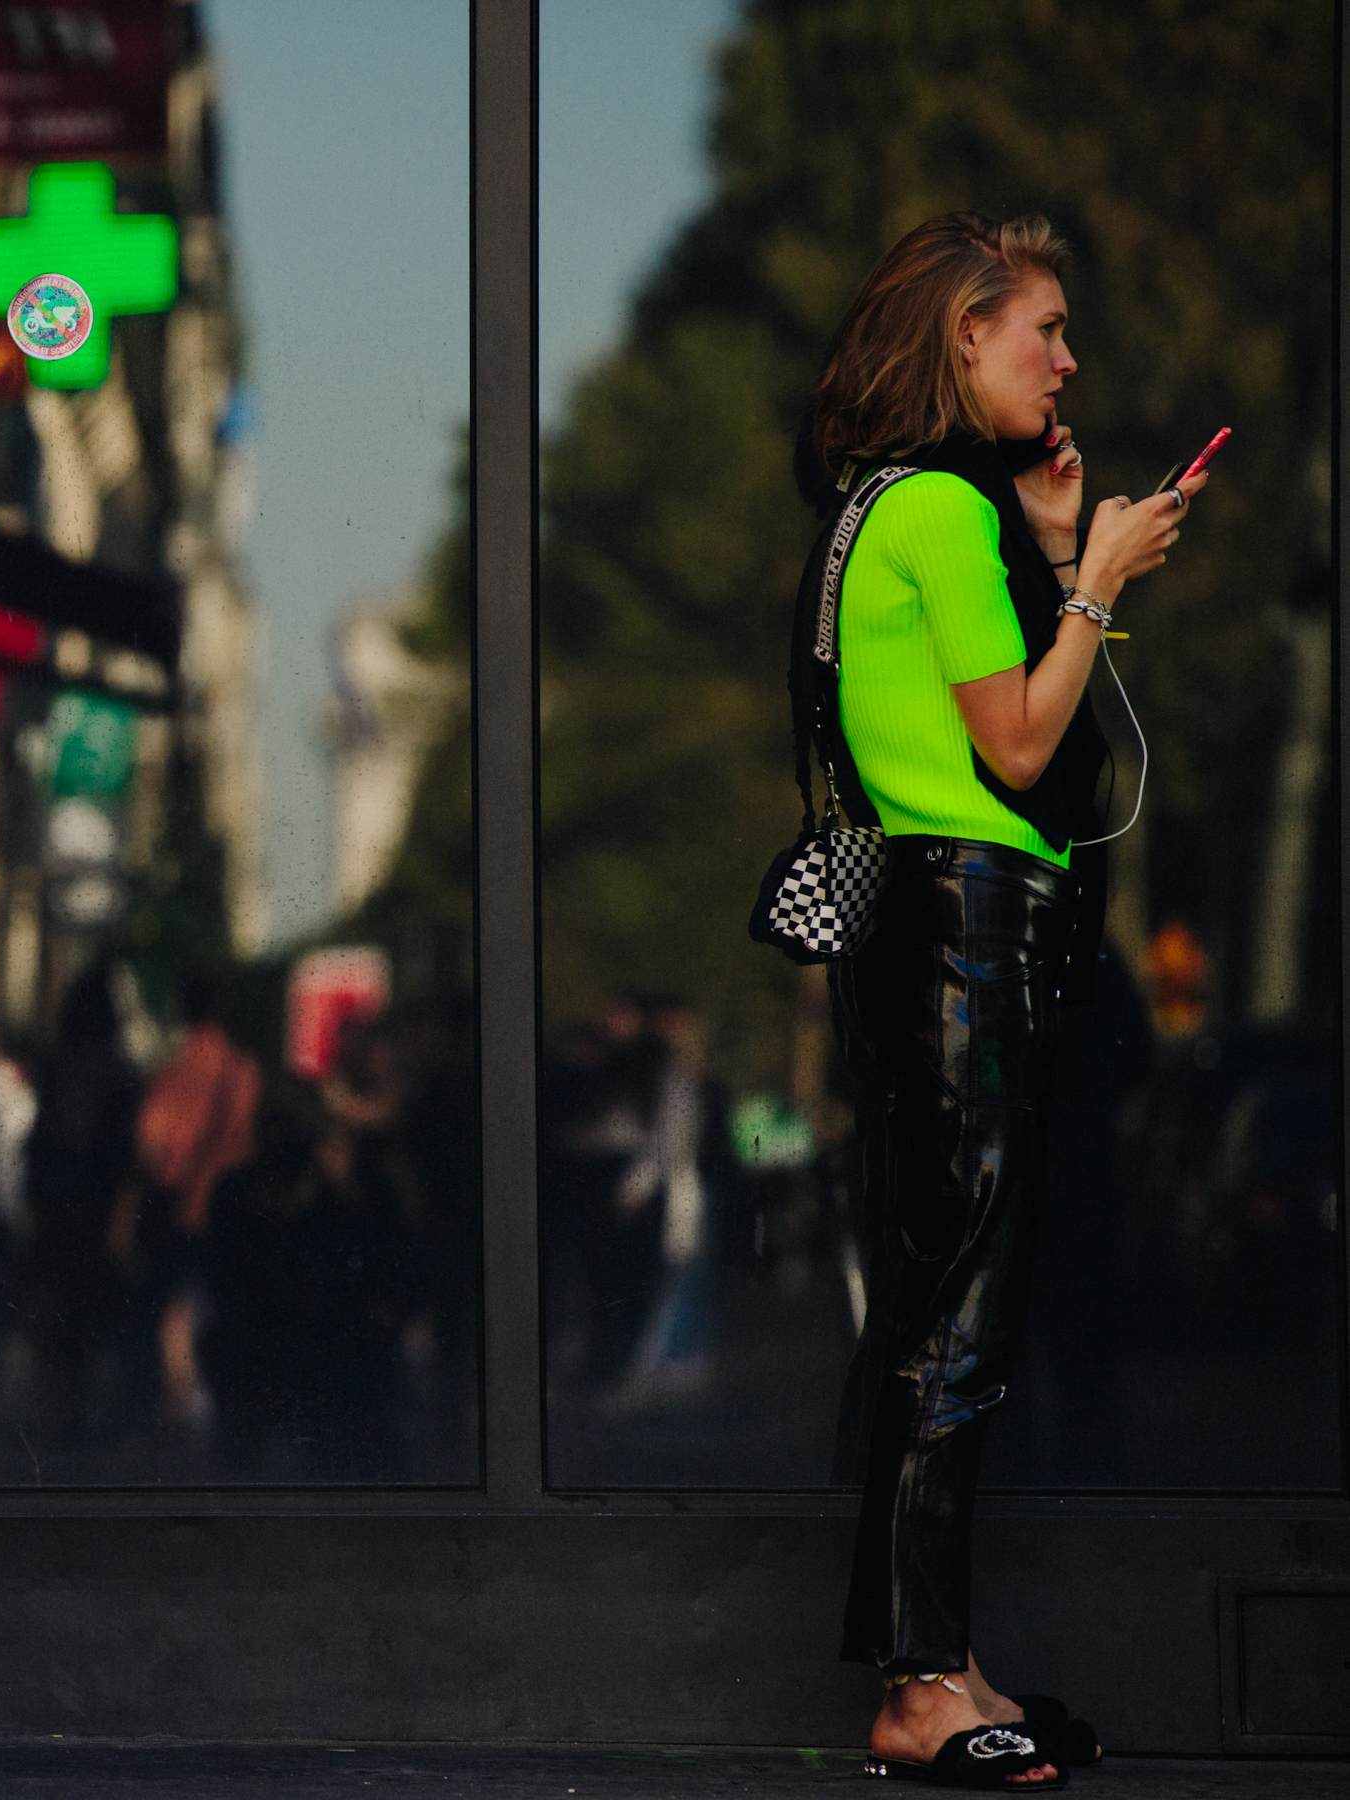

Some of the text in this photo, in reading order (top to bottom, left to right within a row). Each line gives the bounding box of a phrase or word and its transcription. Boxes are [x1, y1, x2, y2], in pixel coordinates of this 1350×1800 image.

[12, 277, 64, 311] STATIONNEMENT
[39, 347, 49, 356] ET
[50, 332, 83, 356] SCOOTERS
[814, 503, 862, 662] CHRISTIAN DIOR
